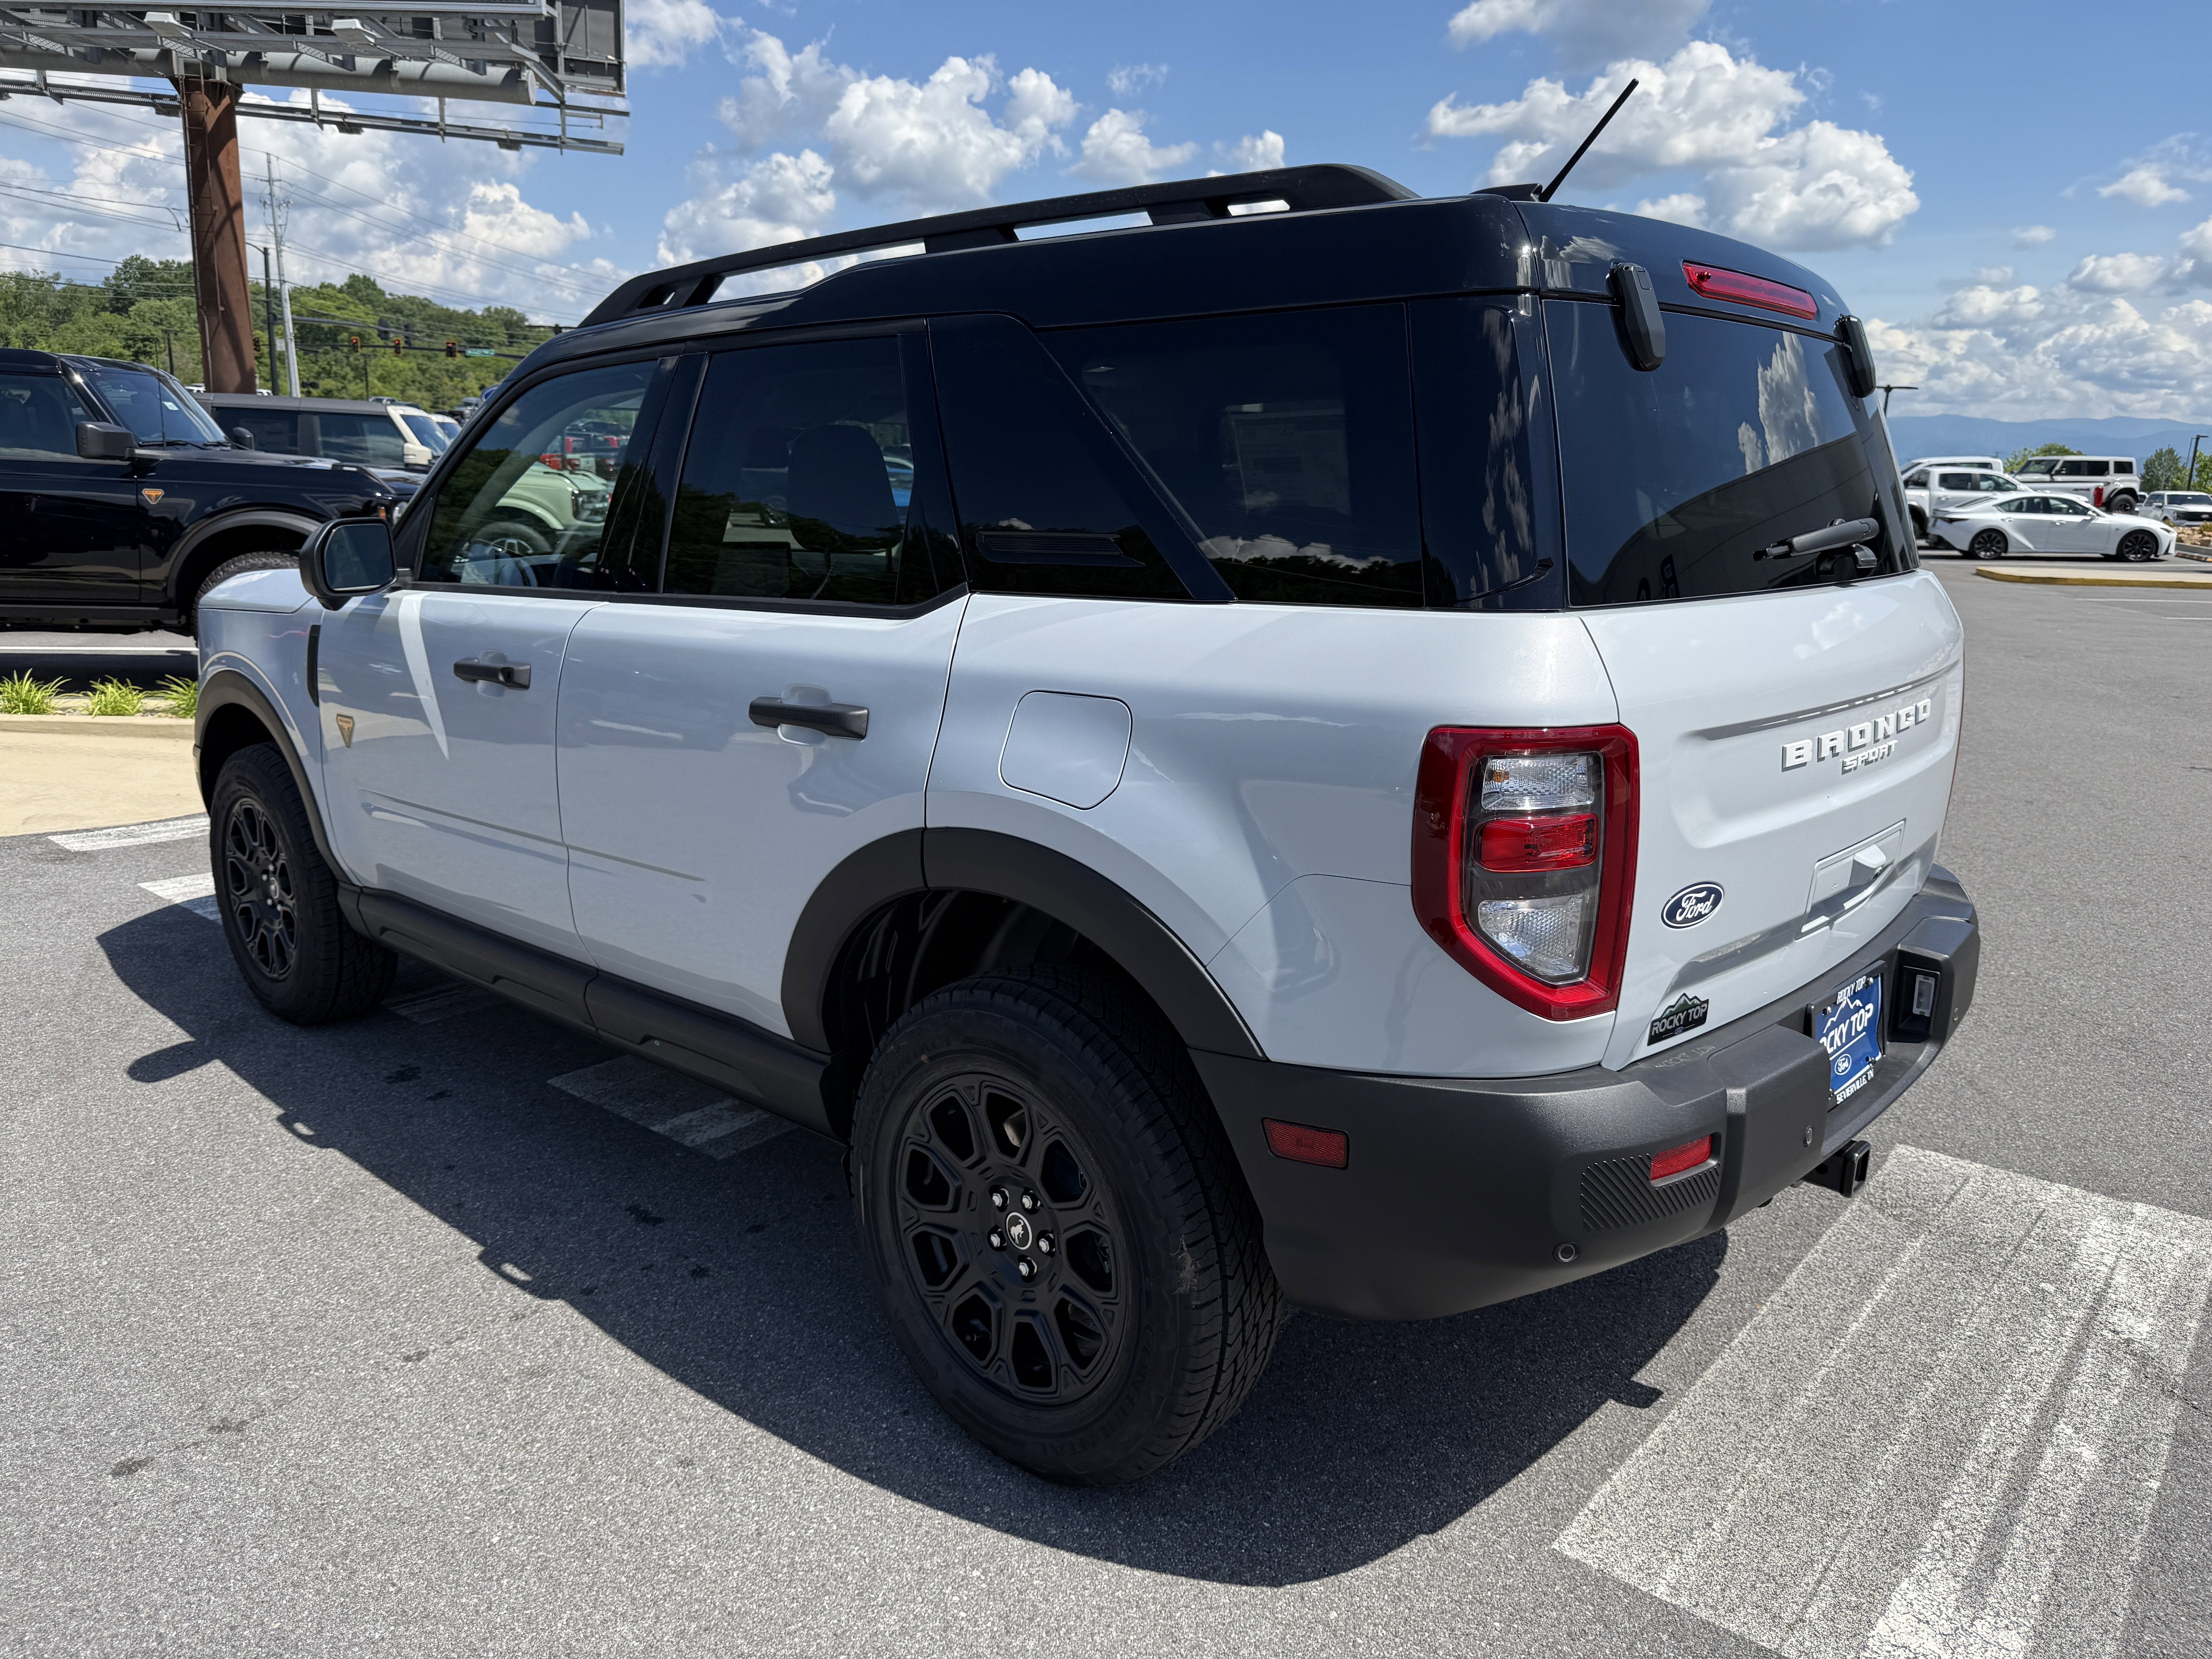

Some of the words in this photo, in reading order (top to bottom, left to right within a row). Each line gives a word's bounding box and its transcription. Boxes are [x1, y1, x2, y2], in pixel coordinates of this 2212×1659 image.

[1782, 698, 1931, 768] BRONCO
[1842, 740, 1898, 771] SPORT
[1676, 891, 1715, 921] Ford
[1836, 982, 1856, 1005] ROCKY
[1855, 975, 1866, 993] TOP
[1651, 1010, 1687, 1036] ROCKY
[1688, 1003, 1708, 1022] TOP
[1850, 1003, 1874, 1036] TOP
[1838, 1057, 1849, 1072] Ford
[1867, 1068, 1874, 1080] TN
